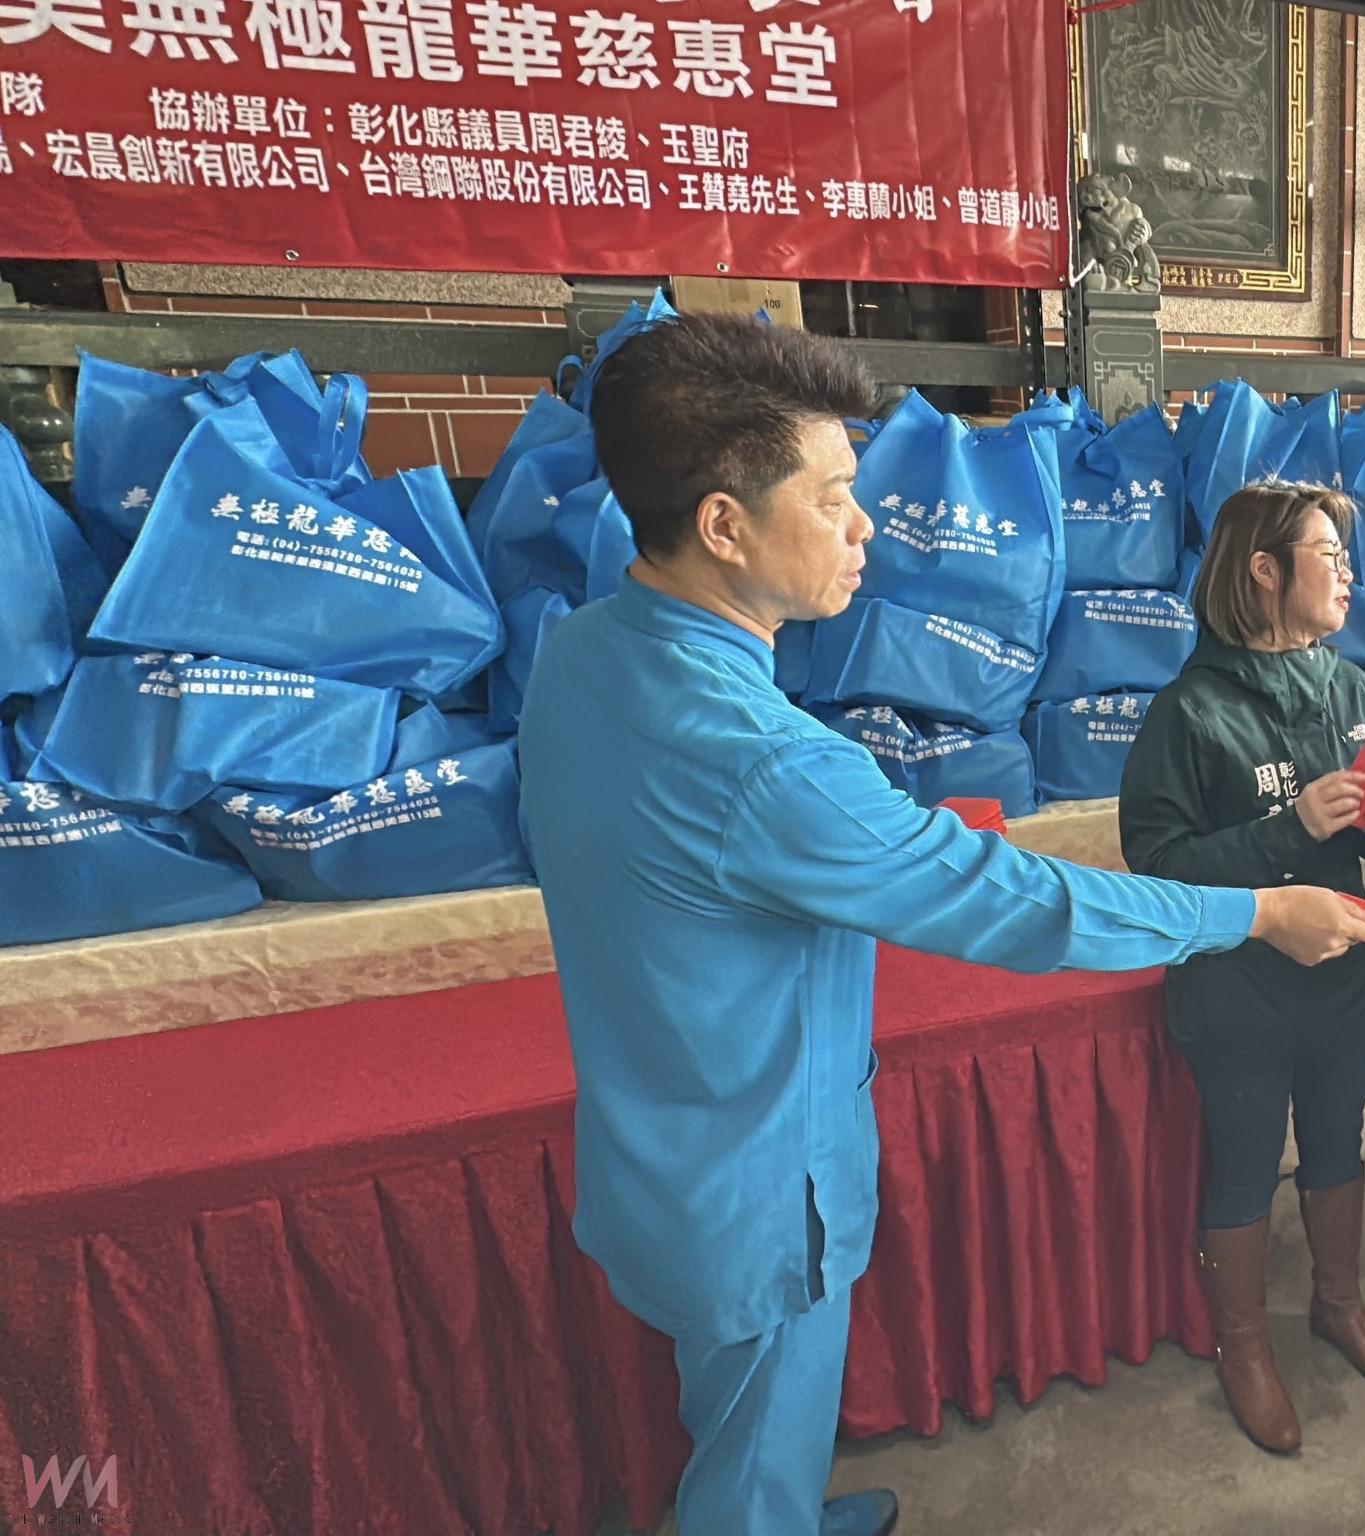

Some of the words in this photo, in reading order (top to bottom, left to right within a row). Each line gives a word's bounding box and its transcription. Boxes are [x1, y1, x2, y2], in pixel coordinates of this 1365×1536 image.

[1070, 696, 1152, 719] 無極龍
[1278, 760, 1299, 807] 彰化
